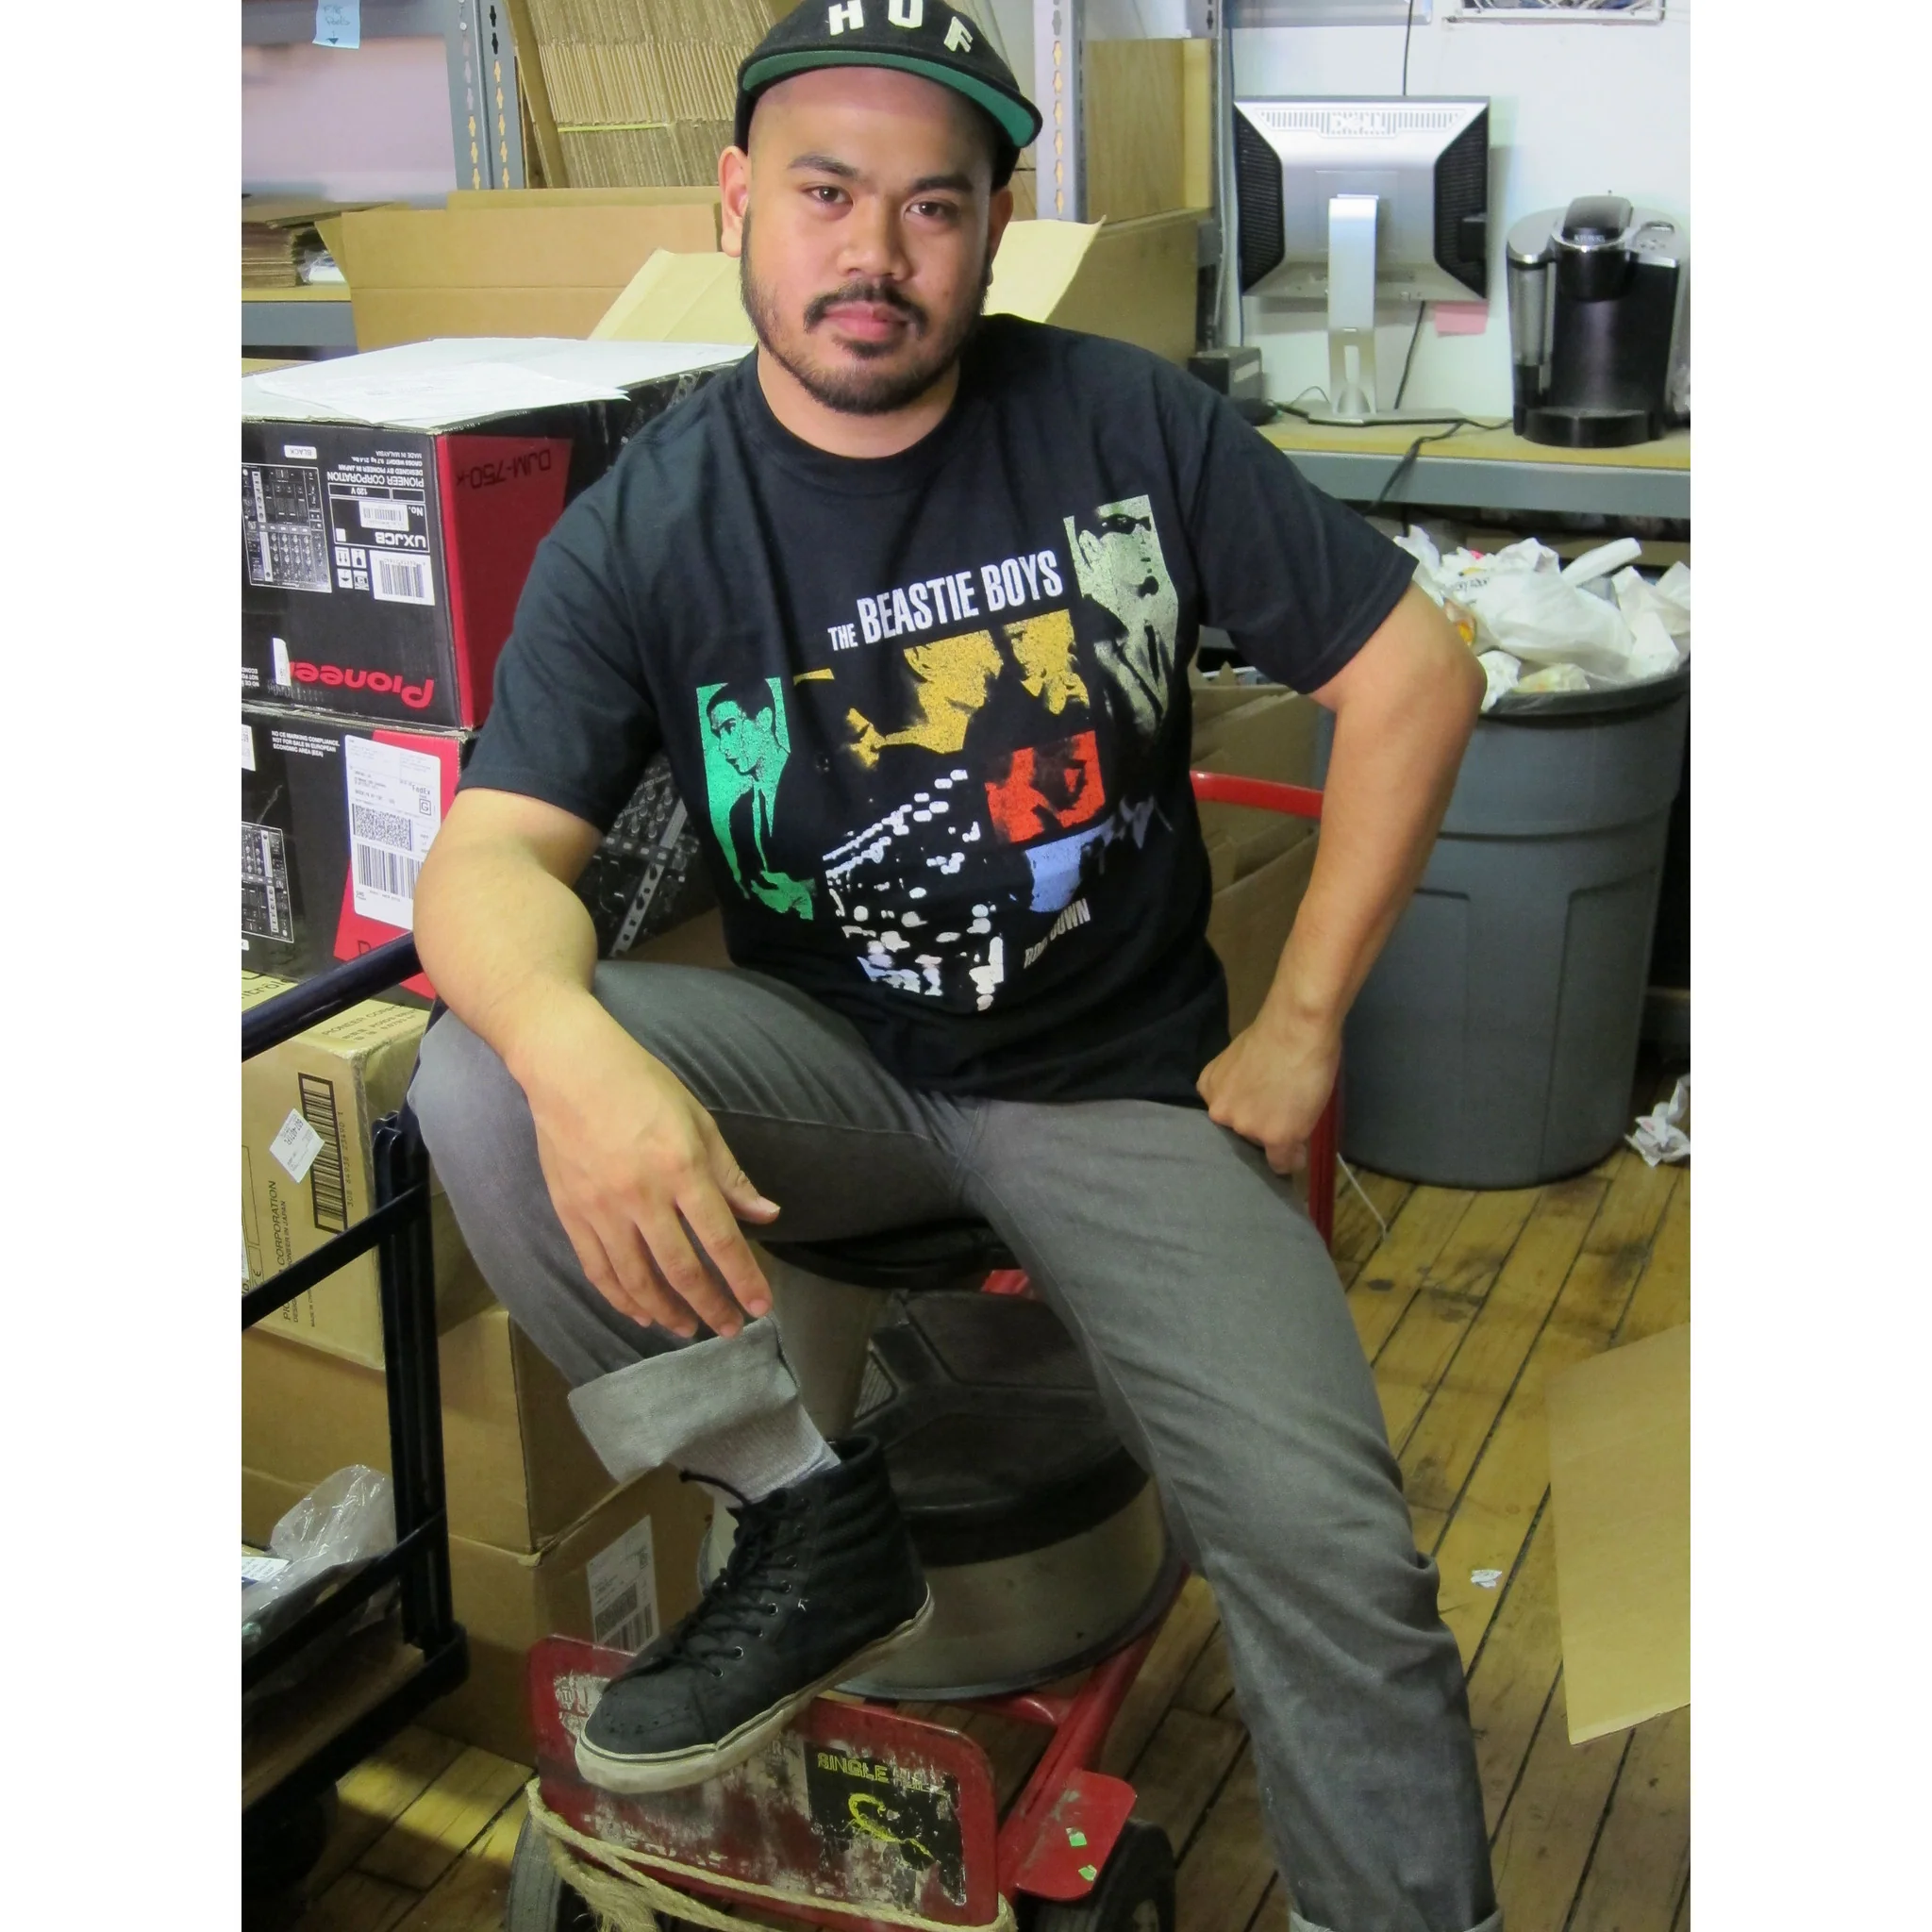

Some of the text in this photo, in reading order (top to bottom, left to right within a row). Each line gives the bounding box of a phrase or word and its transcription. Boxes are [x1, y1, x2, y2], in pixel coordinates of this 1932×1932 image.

[828, 0, 974, 52] HUF
[290, 448, 312, 457] BLACK
[362, 465, 386, 474] PIONEER
[326, 471, 425, 488] PIONEER CORPORATION
[408, 506, 424, 517] No.
[375, 531, 426, 548] UXJCB
[827, 549, 1064, 652] THE BEASTIE BOYS
[286, 732, 308, 741] MARKING
[273, 742, 298, 753] ECONOMIC
[310, 742, 337, 753] EUROPEAN
[268, 1180, 285, 1266] CORPORATION
